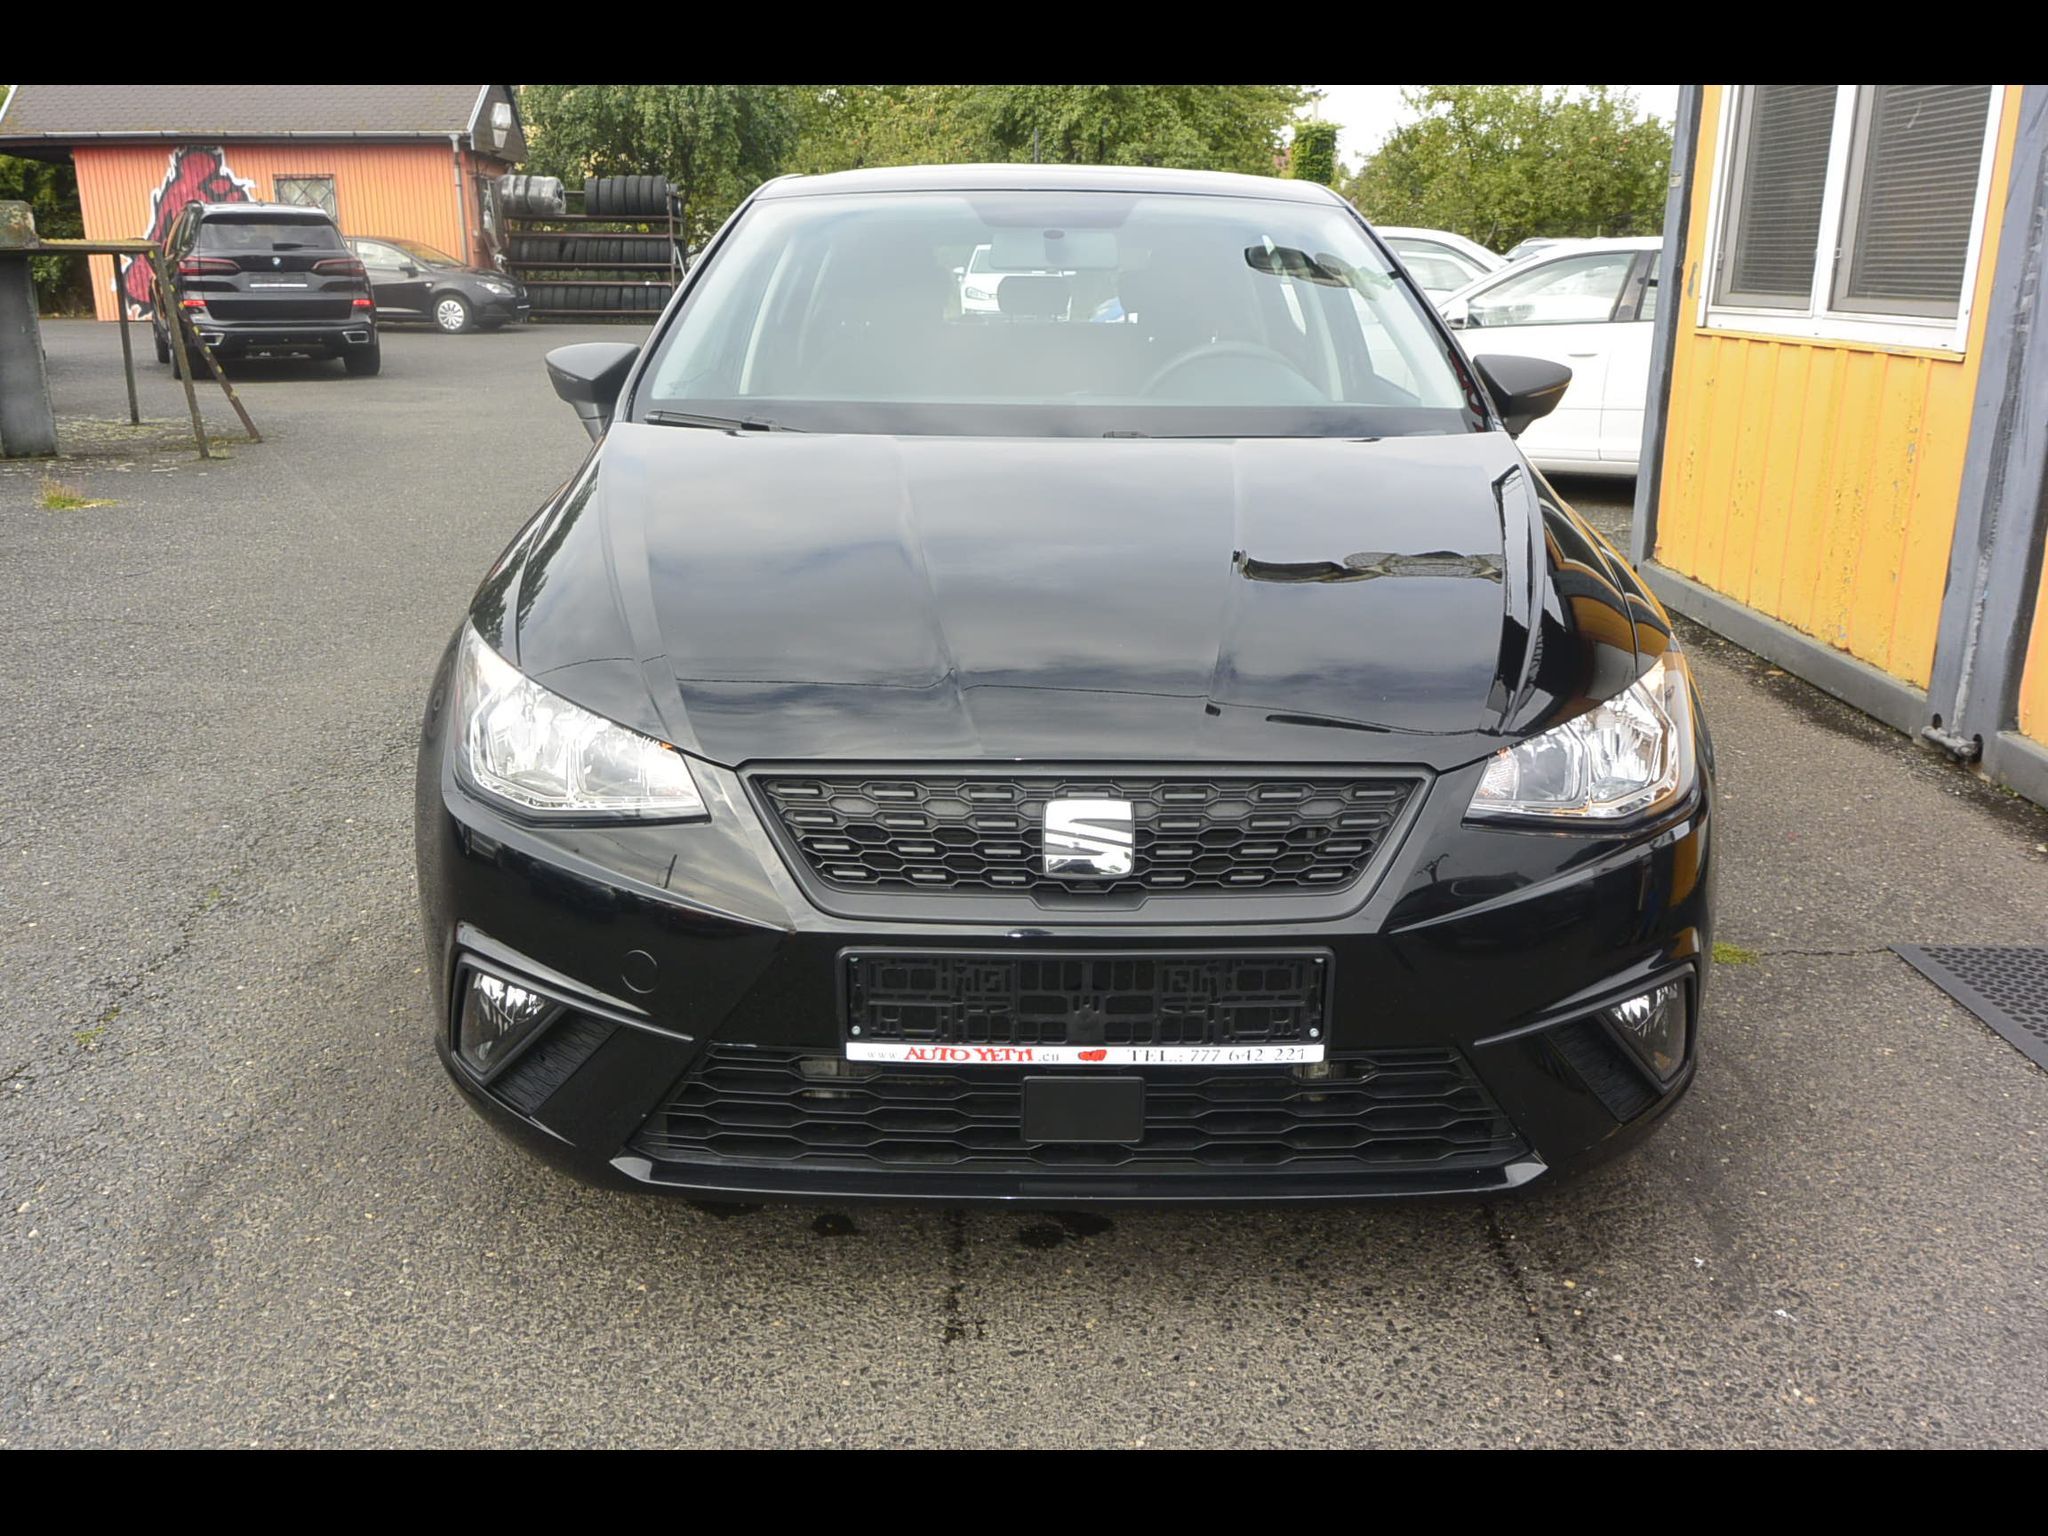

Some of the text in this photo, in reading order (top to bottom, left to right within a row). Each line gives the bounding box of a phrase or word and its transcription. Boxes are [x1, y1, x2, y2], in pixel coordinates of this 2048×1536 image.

[904, 1046, 971, 1062] AUTO
[1191, 1048, 1221, 1062] 777
[1228, 1048, 1264, 1062] 642
[1274, 1047, 1305, 1061] 221
